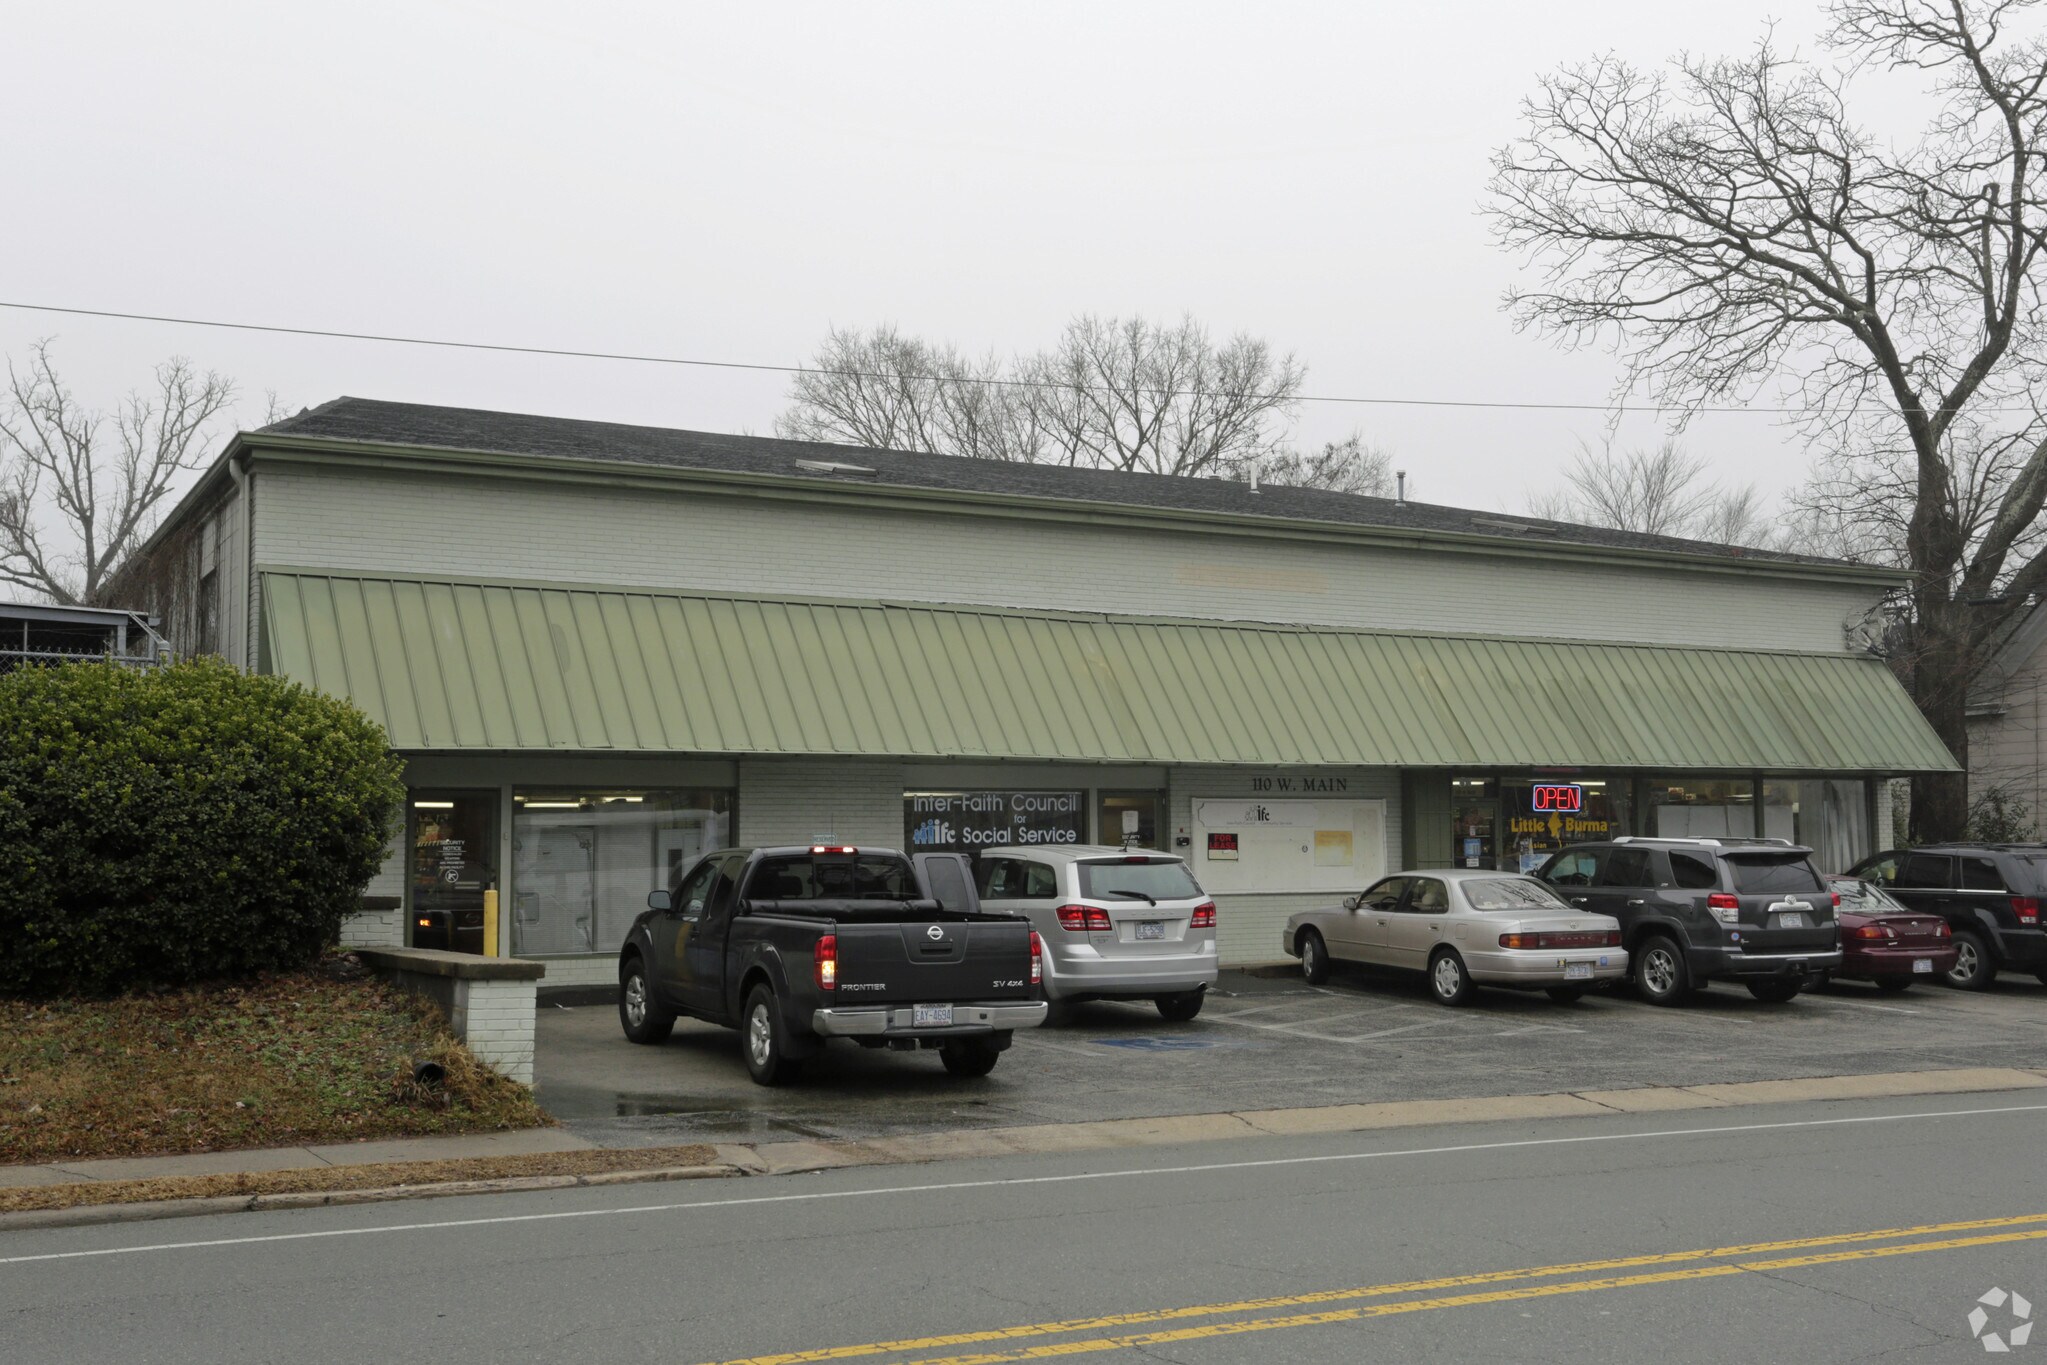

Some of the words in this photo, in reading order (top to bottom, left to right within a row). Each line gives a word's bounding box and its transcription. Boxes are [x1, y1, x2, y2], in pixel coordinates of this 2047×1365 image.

[1252, 778, 1272, 791] 110
[1277, 778, 1297, 791] W.
[1303, 778, 1348, 792] MAIN
[914, 794, 1003, 812] Inter-Faith
[1011, 794, 1077, 812] Council
[1535, 788, 1579, 809] OPEN
[1014, 814, 1027, 824] for
[1257, 804, 1270, 821] ifc
[1511, 818, 1545, 832] Little
[1565, 817, 1608, 832] Burma
[935, 819, 956, 844] ifc
[962, 827, 1012, 844] Social
[1018, 826, 1077, 843] Service
[1214, 834, 1232, 842] FOR
[1209, 841, 1237, 849] LEASE
[841, 983, 886, 991] FRONTIER
[992, 980, 1005, 988] SV
[915, 1009, 951, 1021] EAY-4694
